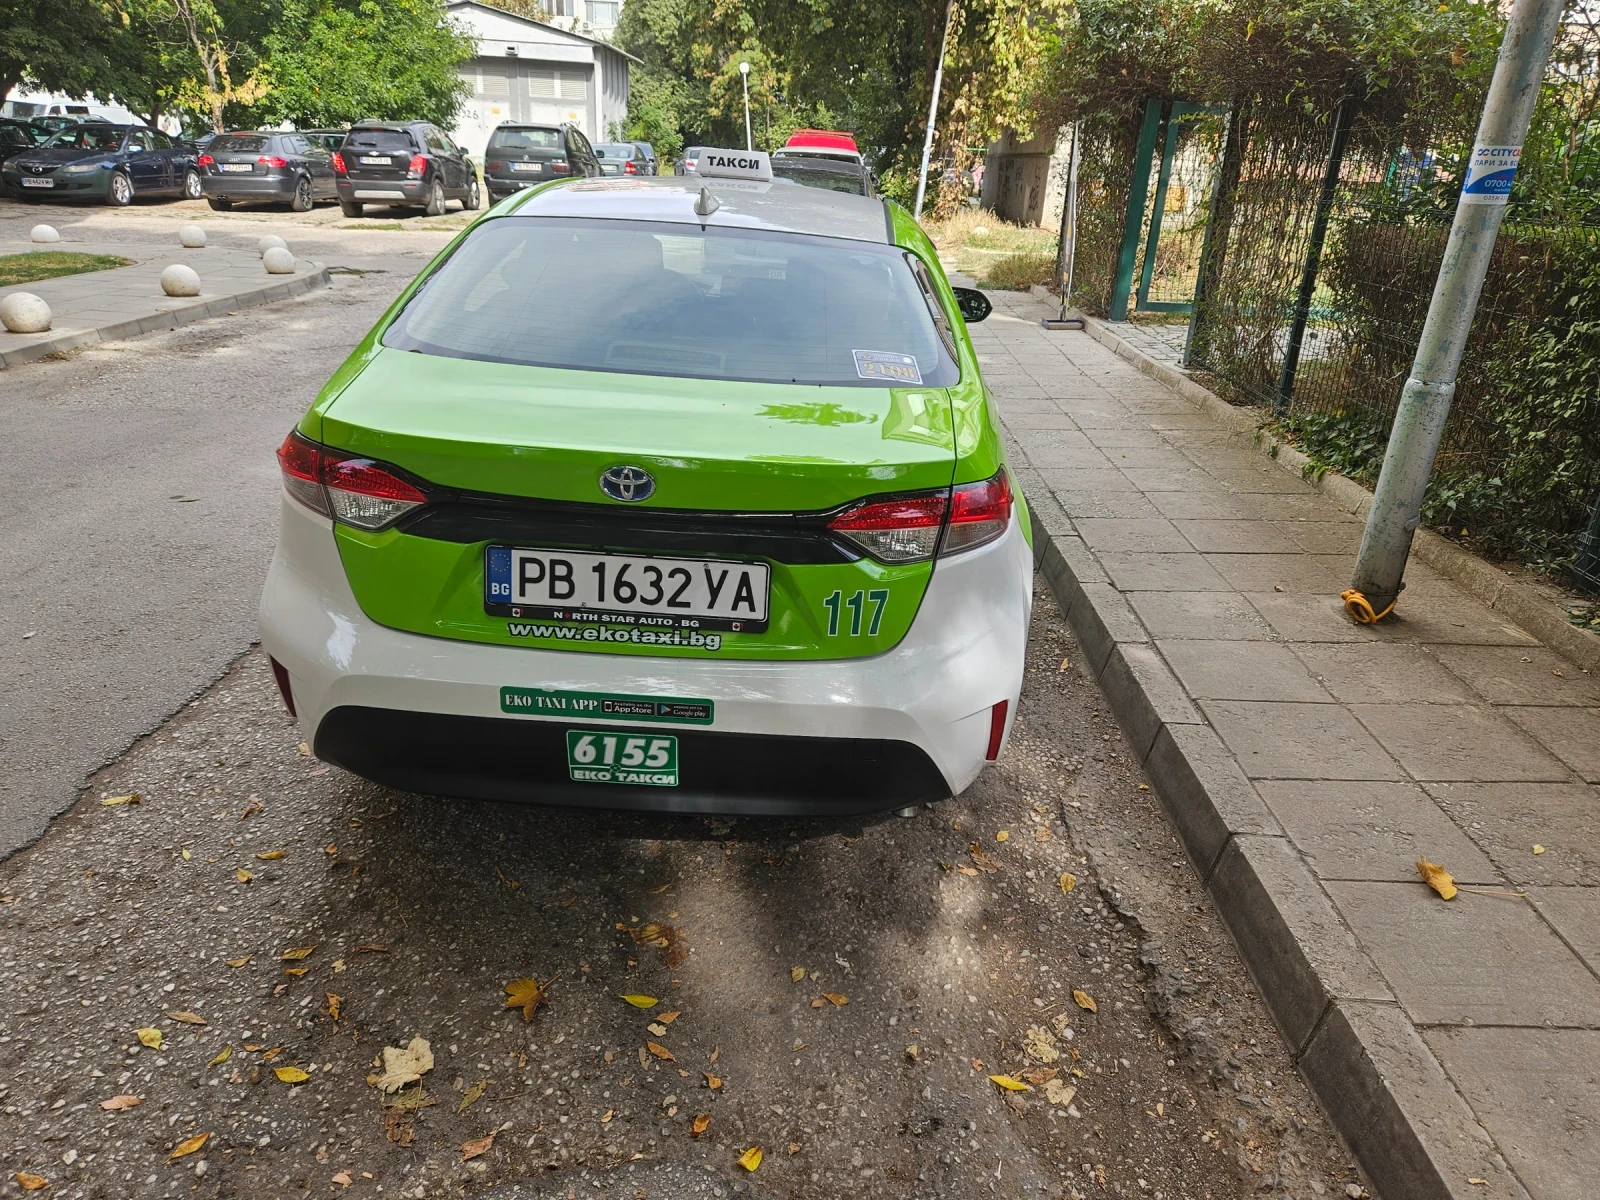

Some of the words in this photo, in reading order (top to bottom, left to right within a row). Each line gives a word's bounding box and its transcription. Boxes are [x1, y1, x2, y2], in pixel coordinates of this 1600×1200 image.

[707, 156, 760, 170] ТАКСИ
[491, 582, 510, 596] BG
[519, 556, 576, 600] PB
[592, 561, 692, 608] 1632
[704, 567, 756, 612] YA
[553, 611, 598, 621] NRTH
[601, 614, 635, 624] STAR
[823, 588, 890, 637] 117
[508, 622, 721, 650] www.ekotaxi.bg
[505, 694, 532, 707] EKO
[536, 696, 566, 710] TAXI
[570, 699, 598, 711] APP
[573, 735, 672, 768] 6155
[573, 770, 612, 781] ЕКО
[615, 773, 676, 784] ТАКСИ
